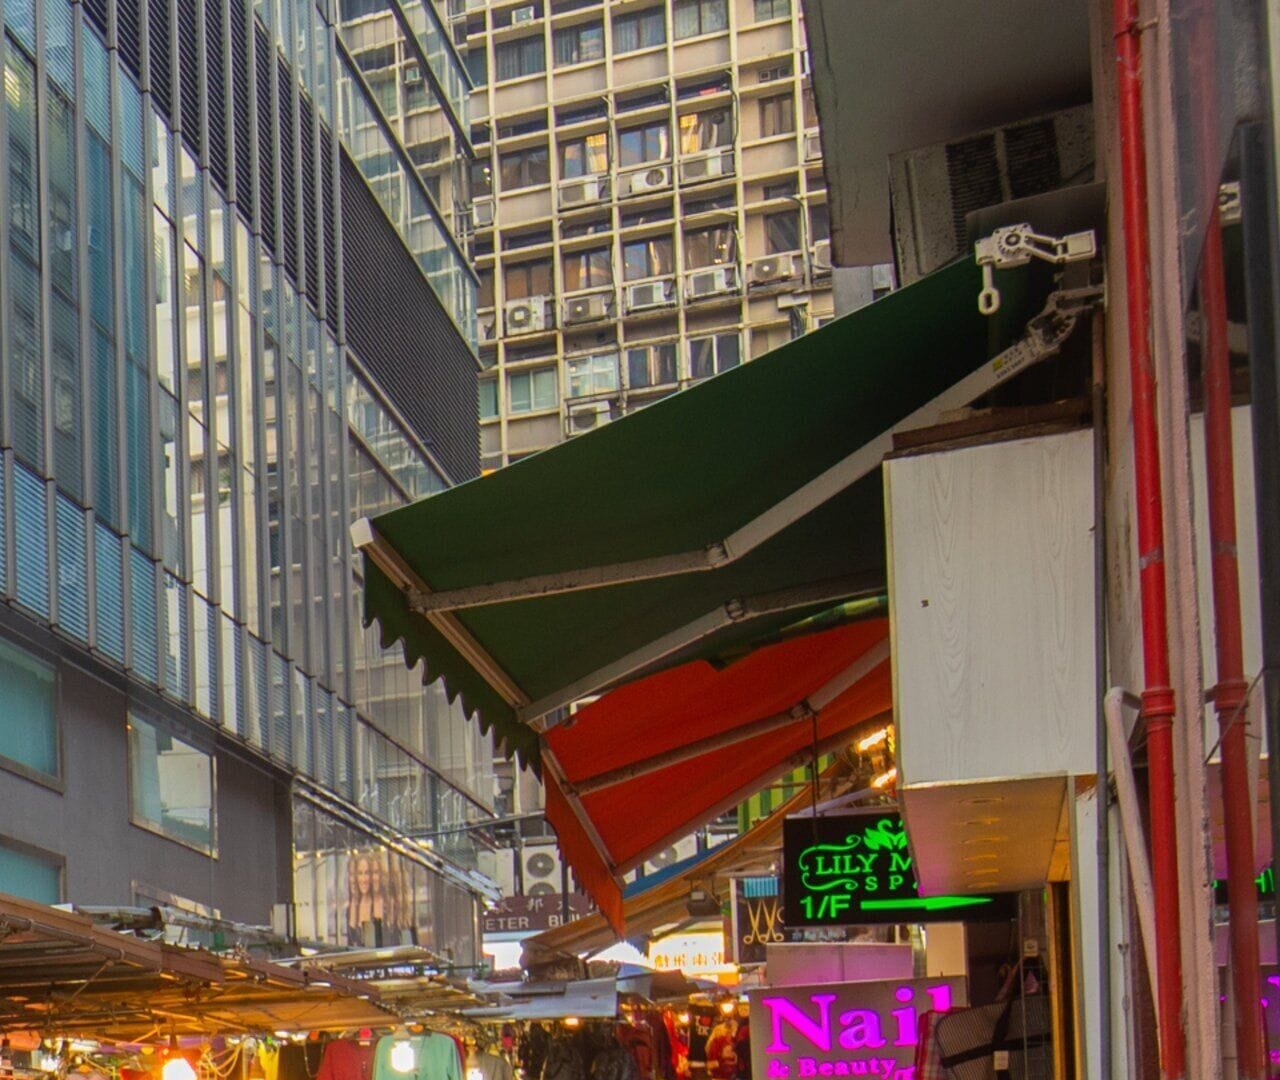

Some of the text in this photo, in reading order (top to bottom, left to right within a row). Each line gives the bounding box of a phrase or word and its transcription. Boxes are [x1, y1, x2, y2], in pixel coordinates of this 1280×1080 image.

[815, 852, 912, 875] LILY M
[865, 875, 918, 891] SP
[800, 894, 851, 919] 1/F
[483, 916, 529, 931] ETER
[767, 1056, 896, 1080] & Beauty
